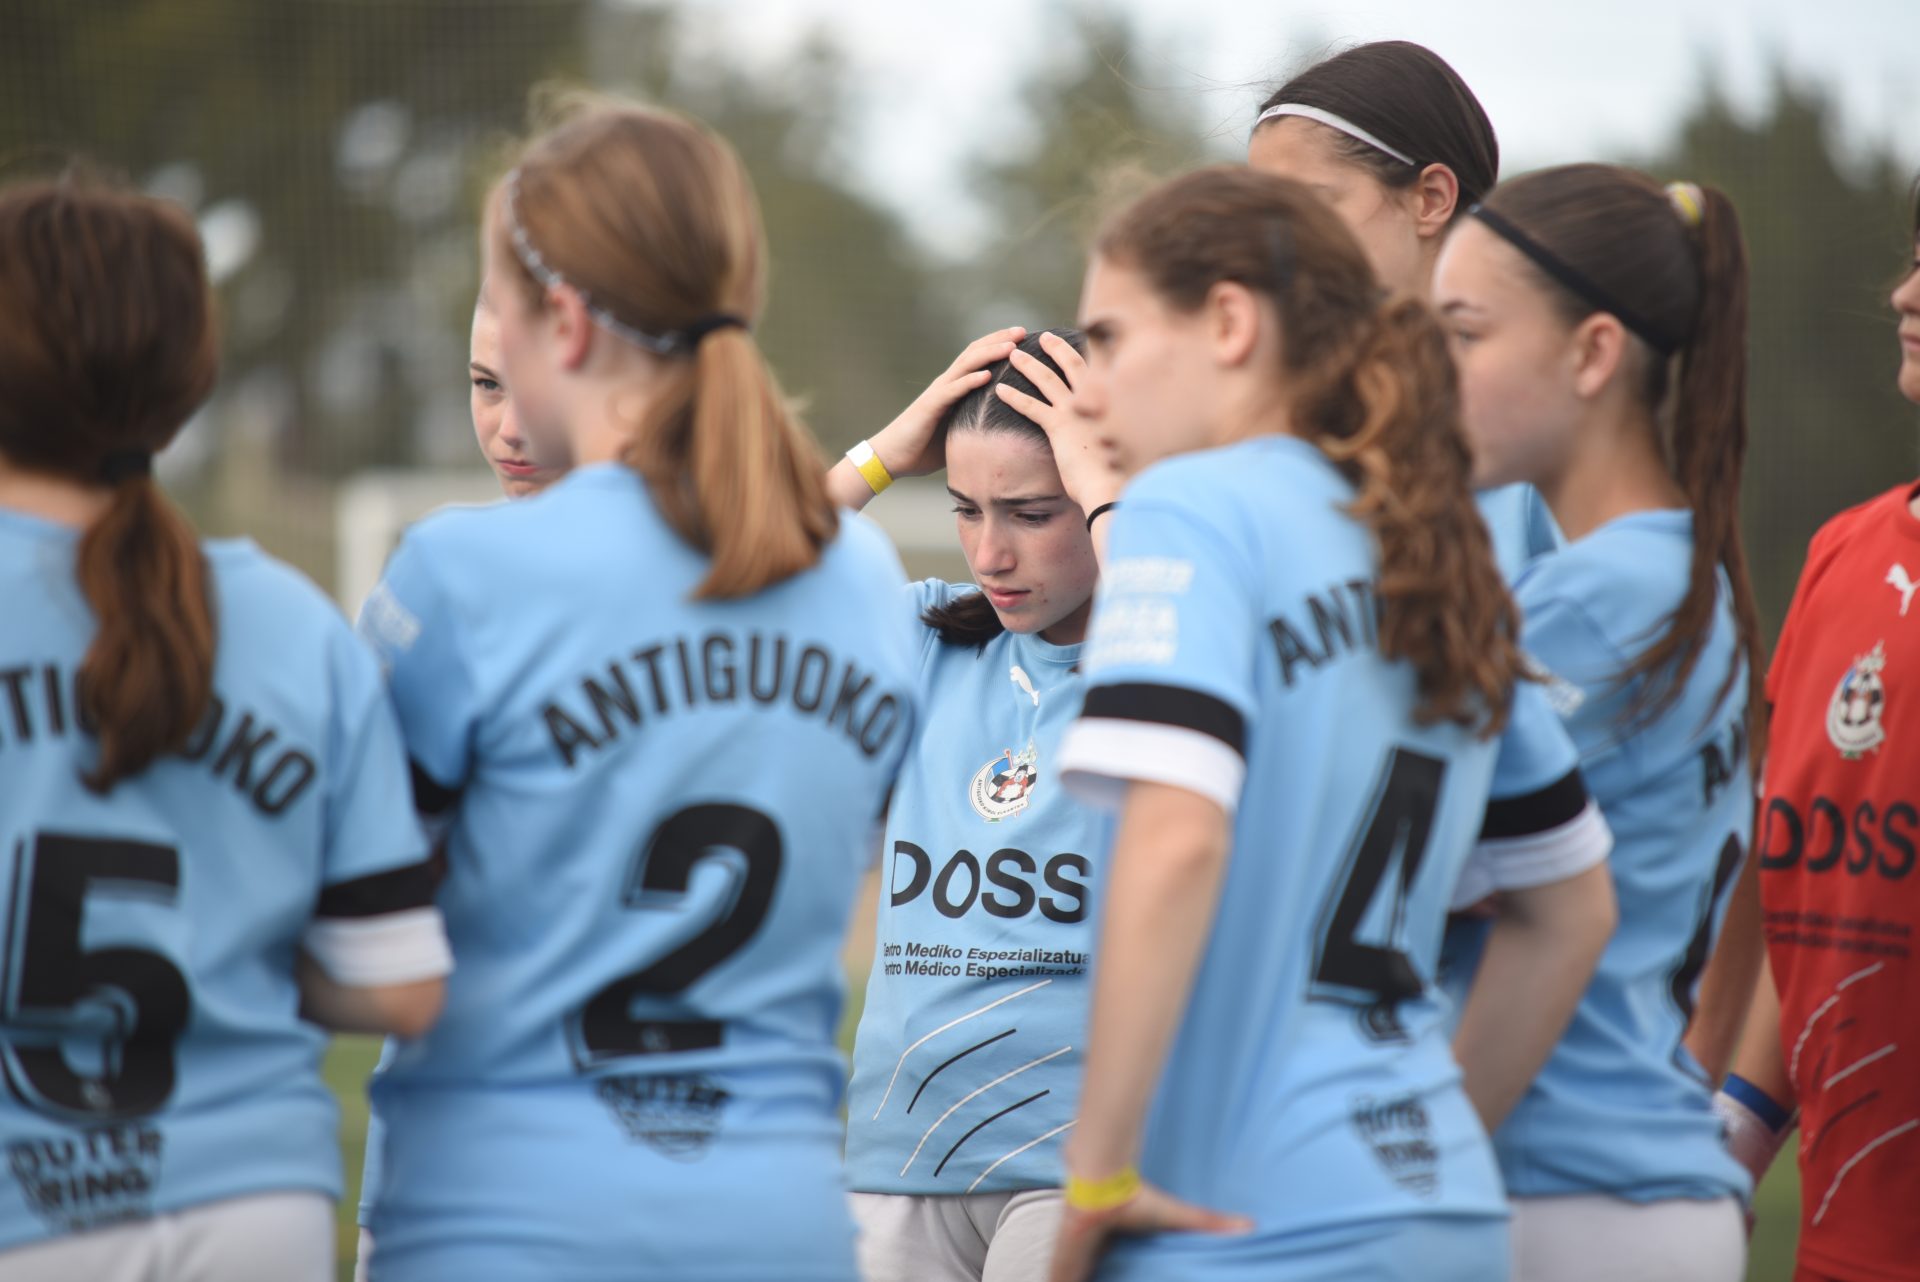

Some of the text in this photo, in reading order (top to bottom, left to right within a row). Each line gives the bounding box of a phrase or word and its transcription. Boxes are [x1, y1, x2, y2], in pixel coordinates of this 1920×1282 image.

[543, 634, 899, 769] ANTIGUOKO
[568, 802, 783, 1071] 2
[891, 840, 1093, 924] DOSS
[1309, 745, 1449, 1042] 4
[4, 830, 192, 1120] 5
[905, 942, 962, 958] Mediko
[905, 959, 961, 977] Médico
